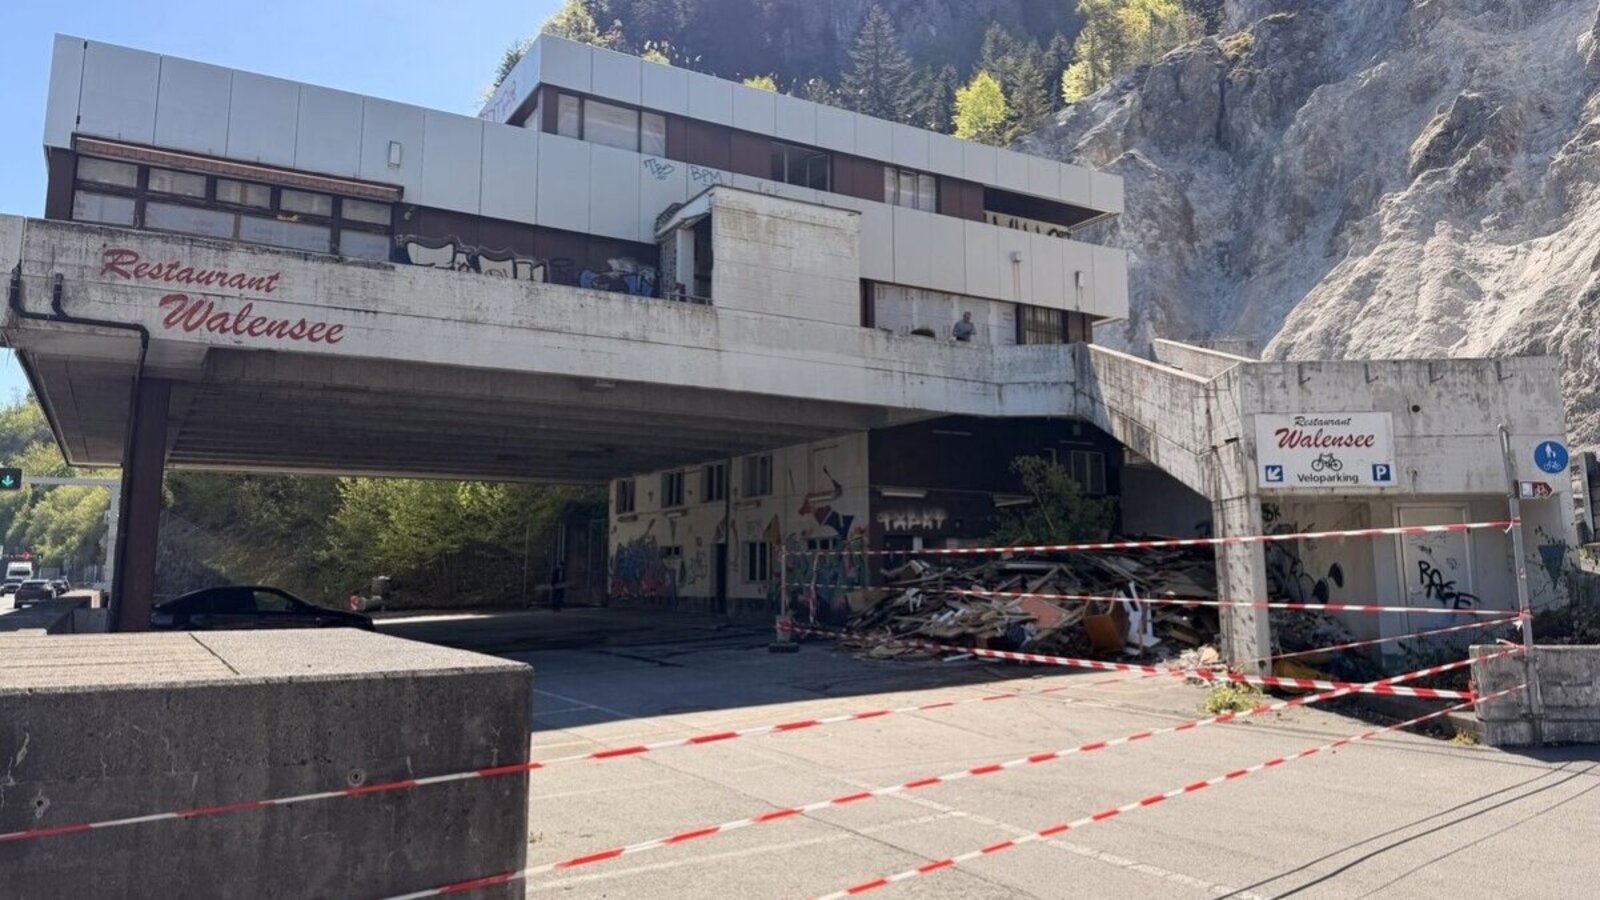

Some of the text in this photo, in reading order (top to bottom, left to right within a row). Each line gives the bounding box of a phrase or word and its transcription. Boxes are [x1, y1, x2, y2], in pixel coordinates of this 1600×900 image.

[100, 249, 280, 293] Restaurant
[159, 293, 344, 344] Walensee
[1294, 415, 1352, 427] Restaurant
[1274, 427, 1375, 449] Walensee
[1297, 473, 1359, 484] Veloparking
[1376, 465, 1387, 480] P
